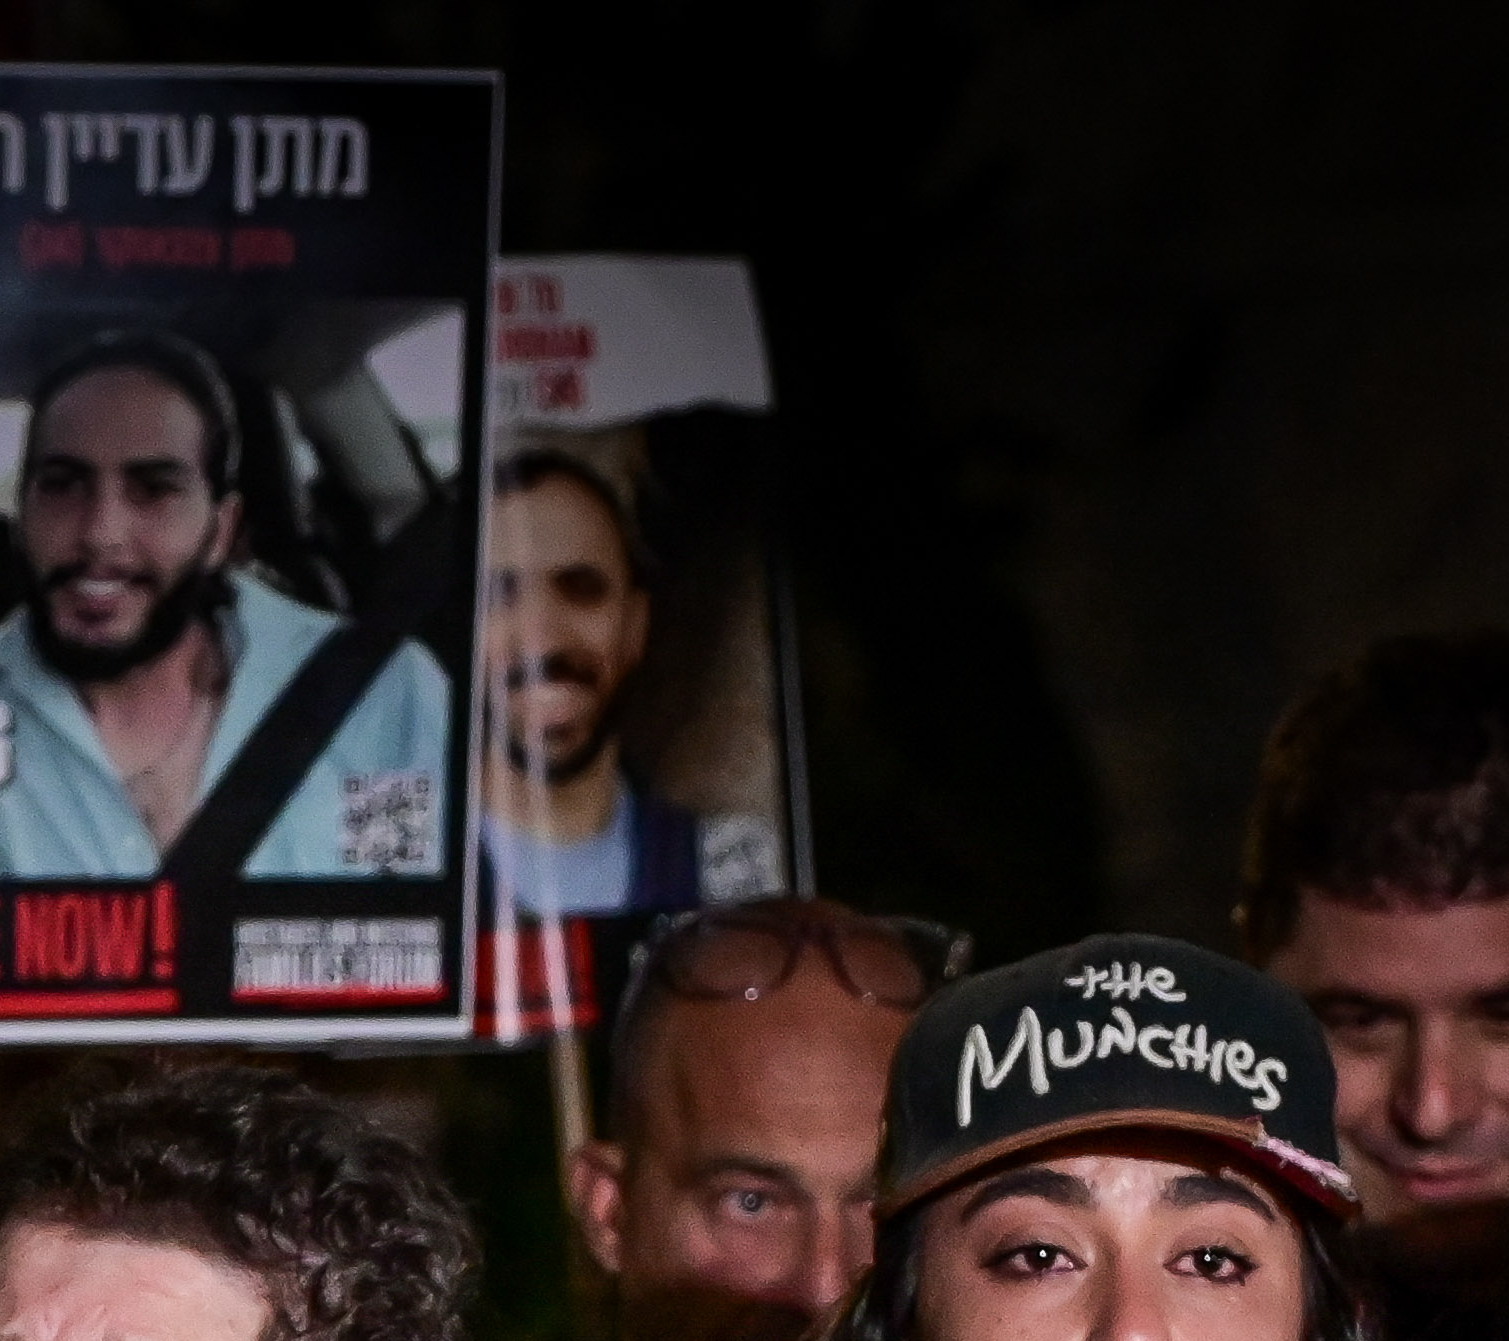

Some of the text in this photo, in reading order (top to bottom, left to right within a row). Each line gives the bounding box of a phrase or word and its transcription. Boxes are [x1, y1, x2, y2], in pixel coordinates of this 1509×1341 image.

[40, 111, 215, 212] עדיין
[229, 113, 370, 214] מתן
[14, 880, 175, 981] NOW!
